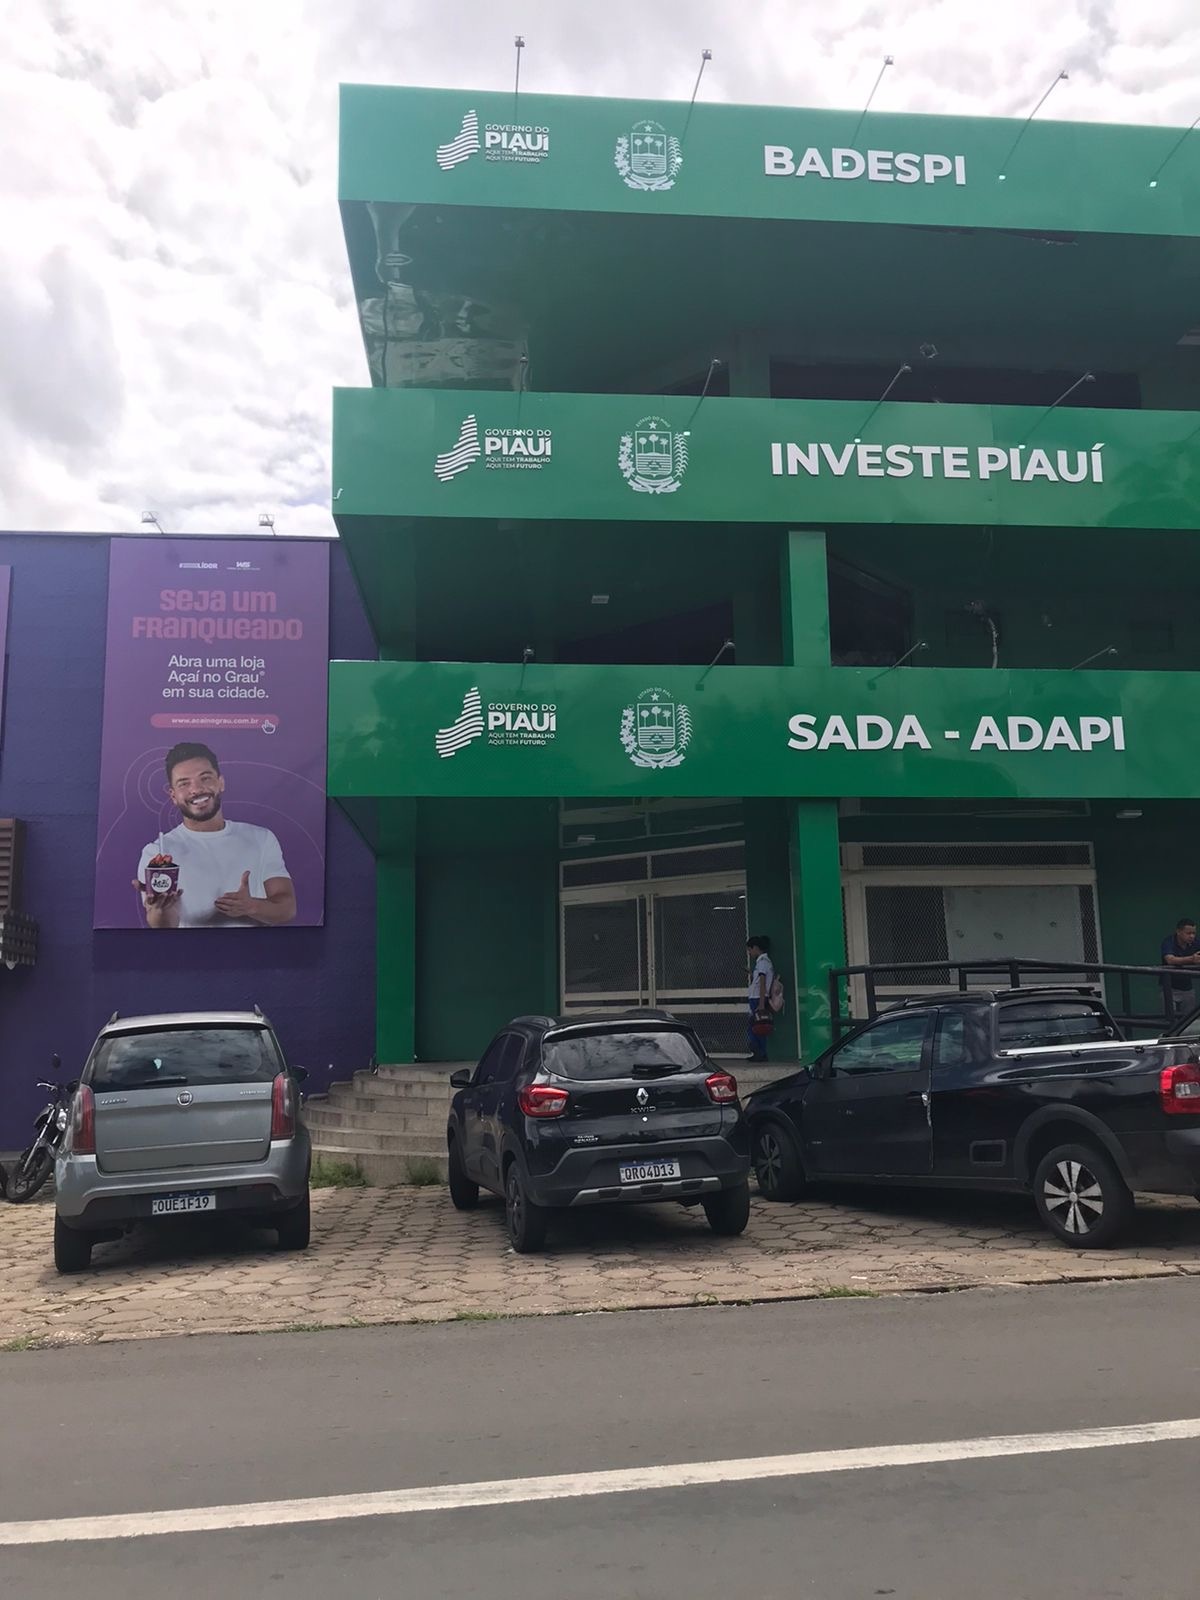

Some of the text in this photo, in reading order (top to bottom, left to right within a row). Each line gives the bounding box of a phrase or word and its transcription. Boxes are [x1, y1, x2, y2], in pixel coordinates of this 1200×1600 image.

[485, 124, 550, 134] GOVERNO DO
[485, 131, 549, 151] PIAUÍ
[764, 145, 966, 185] BADESPI
[485, 428, 552, 437] GOVERNO DO
[485, 437, 552, 456] PIAUÍ
[771, 443, 1105, 482] INVESTE PIAUÍ
[233, 591, 276, 612] um
[168, 655, 265, 671] Abra uma loja
[168, 670, 200, 686] Açaí
[203, 673, 221, 683] no
[162, 686, 269, 698] em sua cidade.
[488, 703, 538, 711] GOVERNO
[488, 711, 556, 731] PIAUÍ
[787, 714, 1125, 751] SADA - ADAPI
